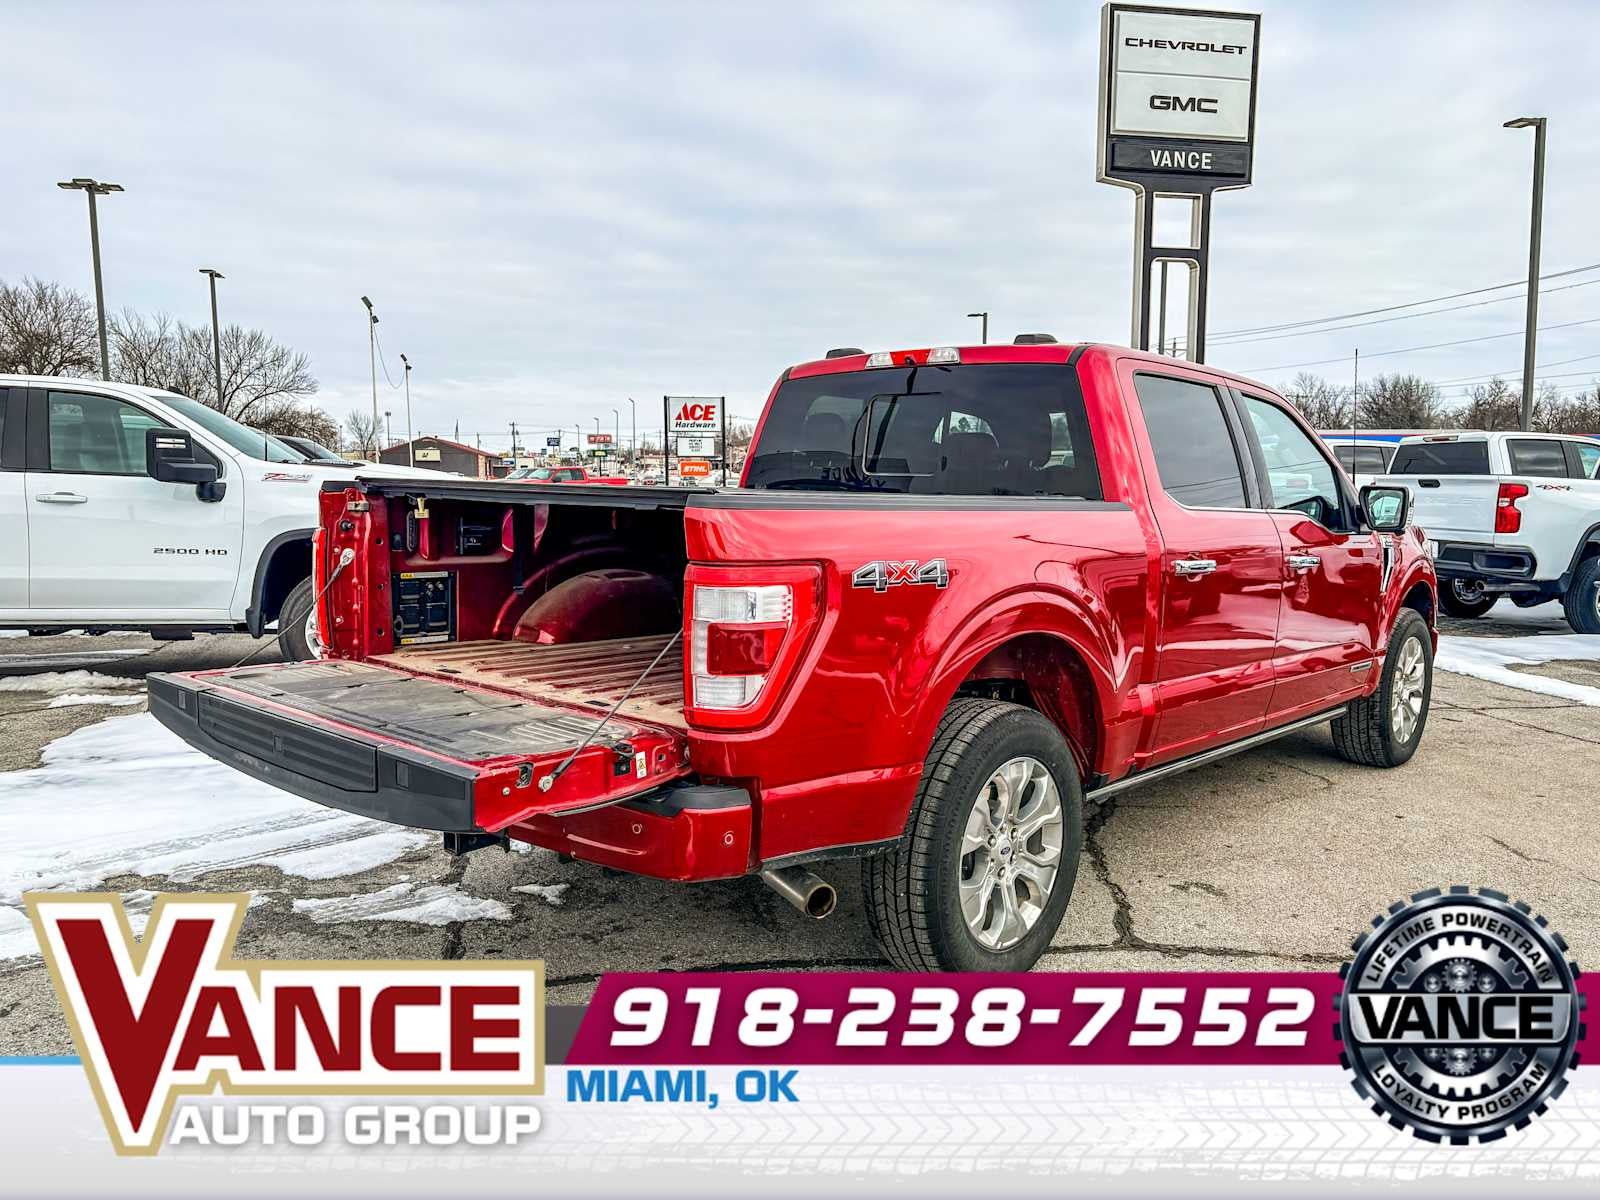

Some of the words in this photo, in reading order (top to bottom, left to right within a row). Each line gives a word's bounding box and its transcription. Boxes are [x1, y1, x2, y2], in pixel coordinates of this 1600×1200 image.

[1125, 37, 1247, 55] CHEVROLET
[1149, 95, 1218, 113] GMC
[1150, 150, 1213, 170] VANCE
[675, 402, 716, 420] ACE
[683, 465, 708, 473] STIHL
